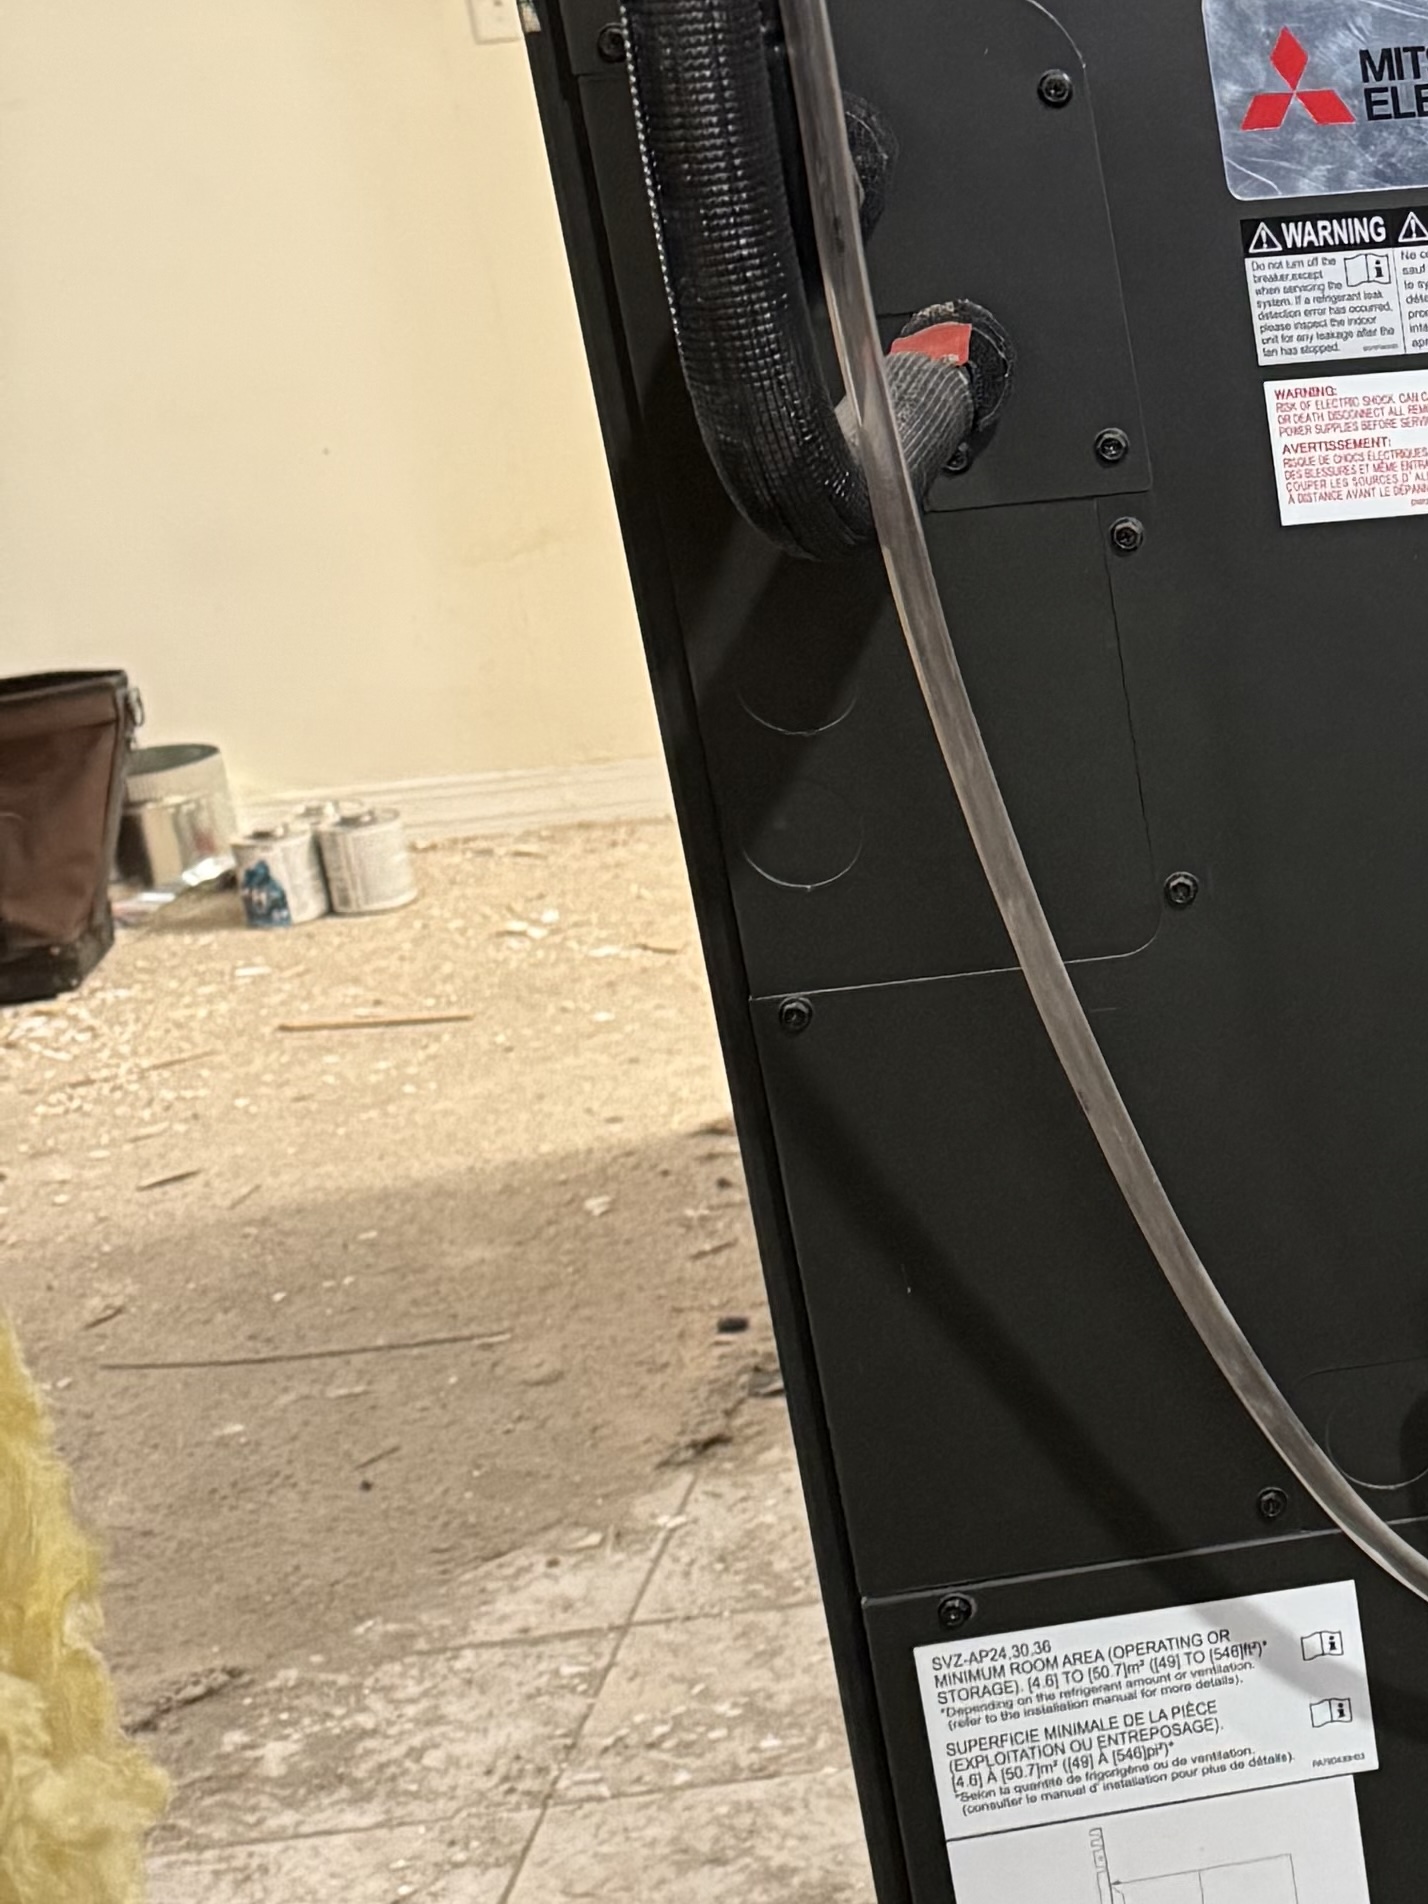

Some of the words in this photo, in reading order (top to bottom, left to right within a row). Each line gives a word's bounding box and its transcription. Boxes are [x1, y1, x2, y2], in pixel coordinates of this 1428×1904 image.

[1280, 215, 1387, 249] WARNING
[933, 1663, 1006, 1689] MINIMUM
[1009, 1655, 1059, 1676] ROOM
[1061, 1648, 1104, 1668] AREA
[1106, 1632, 1203, 1662] (OPERATING
[1206, 1628, 1231, 1645] OR
[936, 1678, 1024, 1706] STORAGE).
[944, 1727, 1041, 1757] SUPERFICIE
[1043, 1715, 1119, 1741] MINIMALE
[1122, 1711, 1145, 1728] DE
[1147, 1708, 1168, 1723] LA
